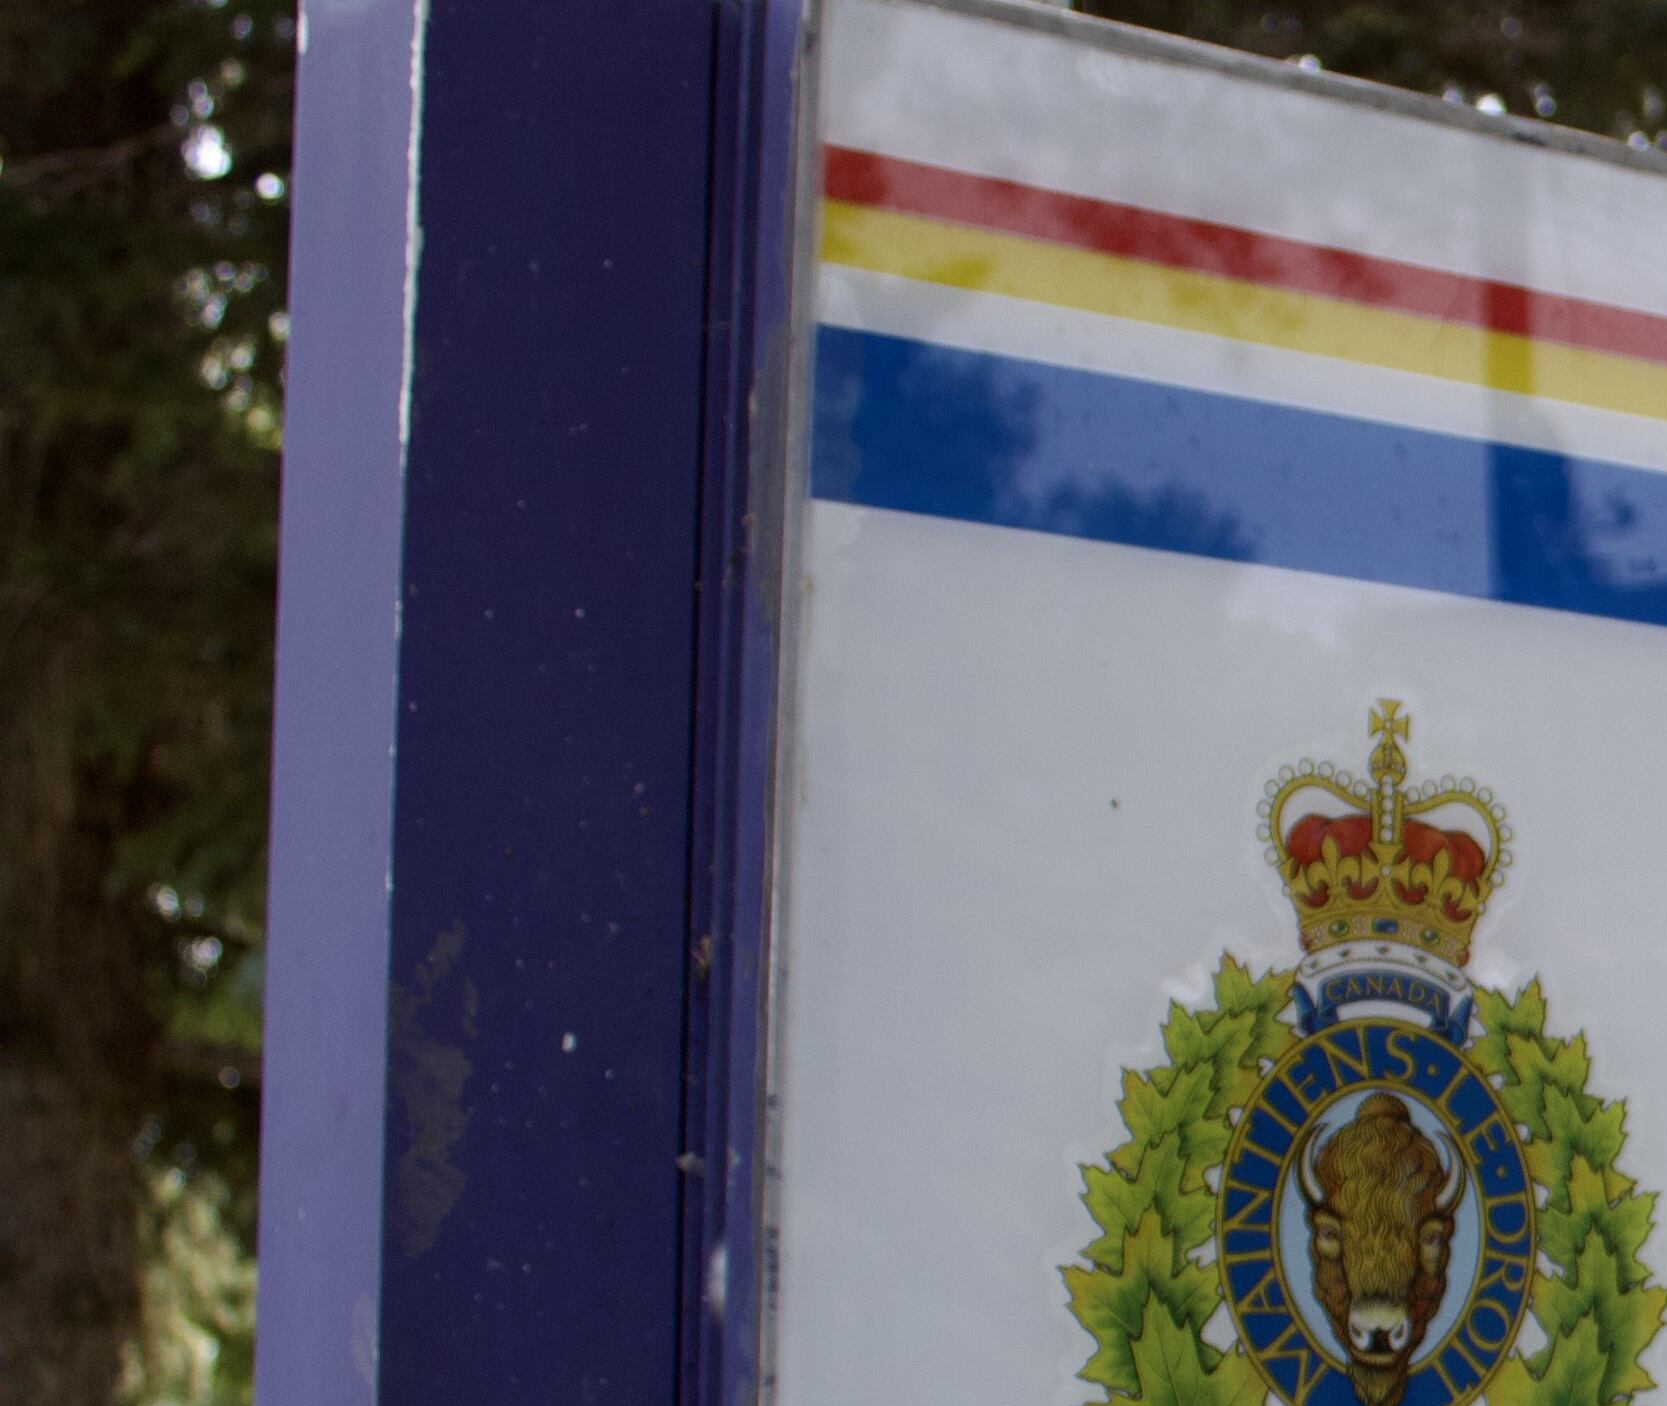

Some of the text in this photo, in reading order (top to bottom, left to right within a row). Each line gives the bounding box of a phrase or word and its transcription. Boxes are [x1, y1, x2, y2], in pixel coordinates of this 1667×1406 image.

[1326, 975, 1442, 1014] CANADA
[1223, 1024, 1416, 1402] MAINTIENS
[1435, 1069, 1512, 1166] LE
